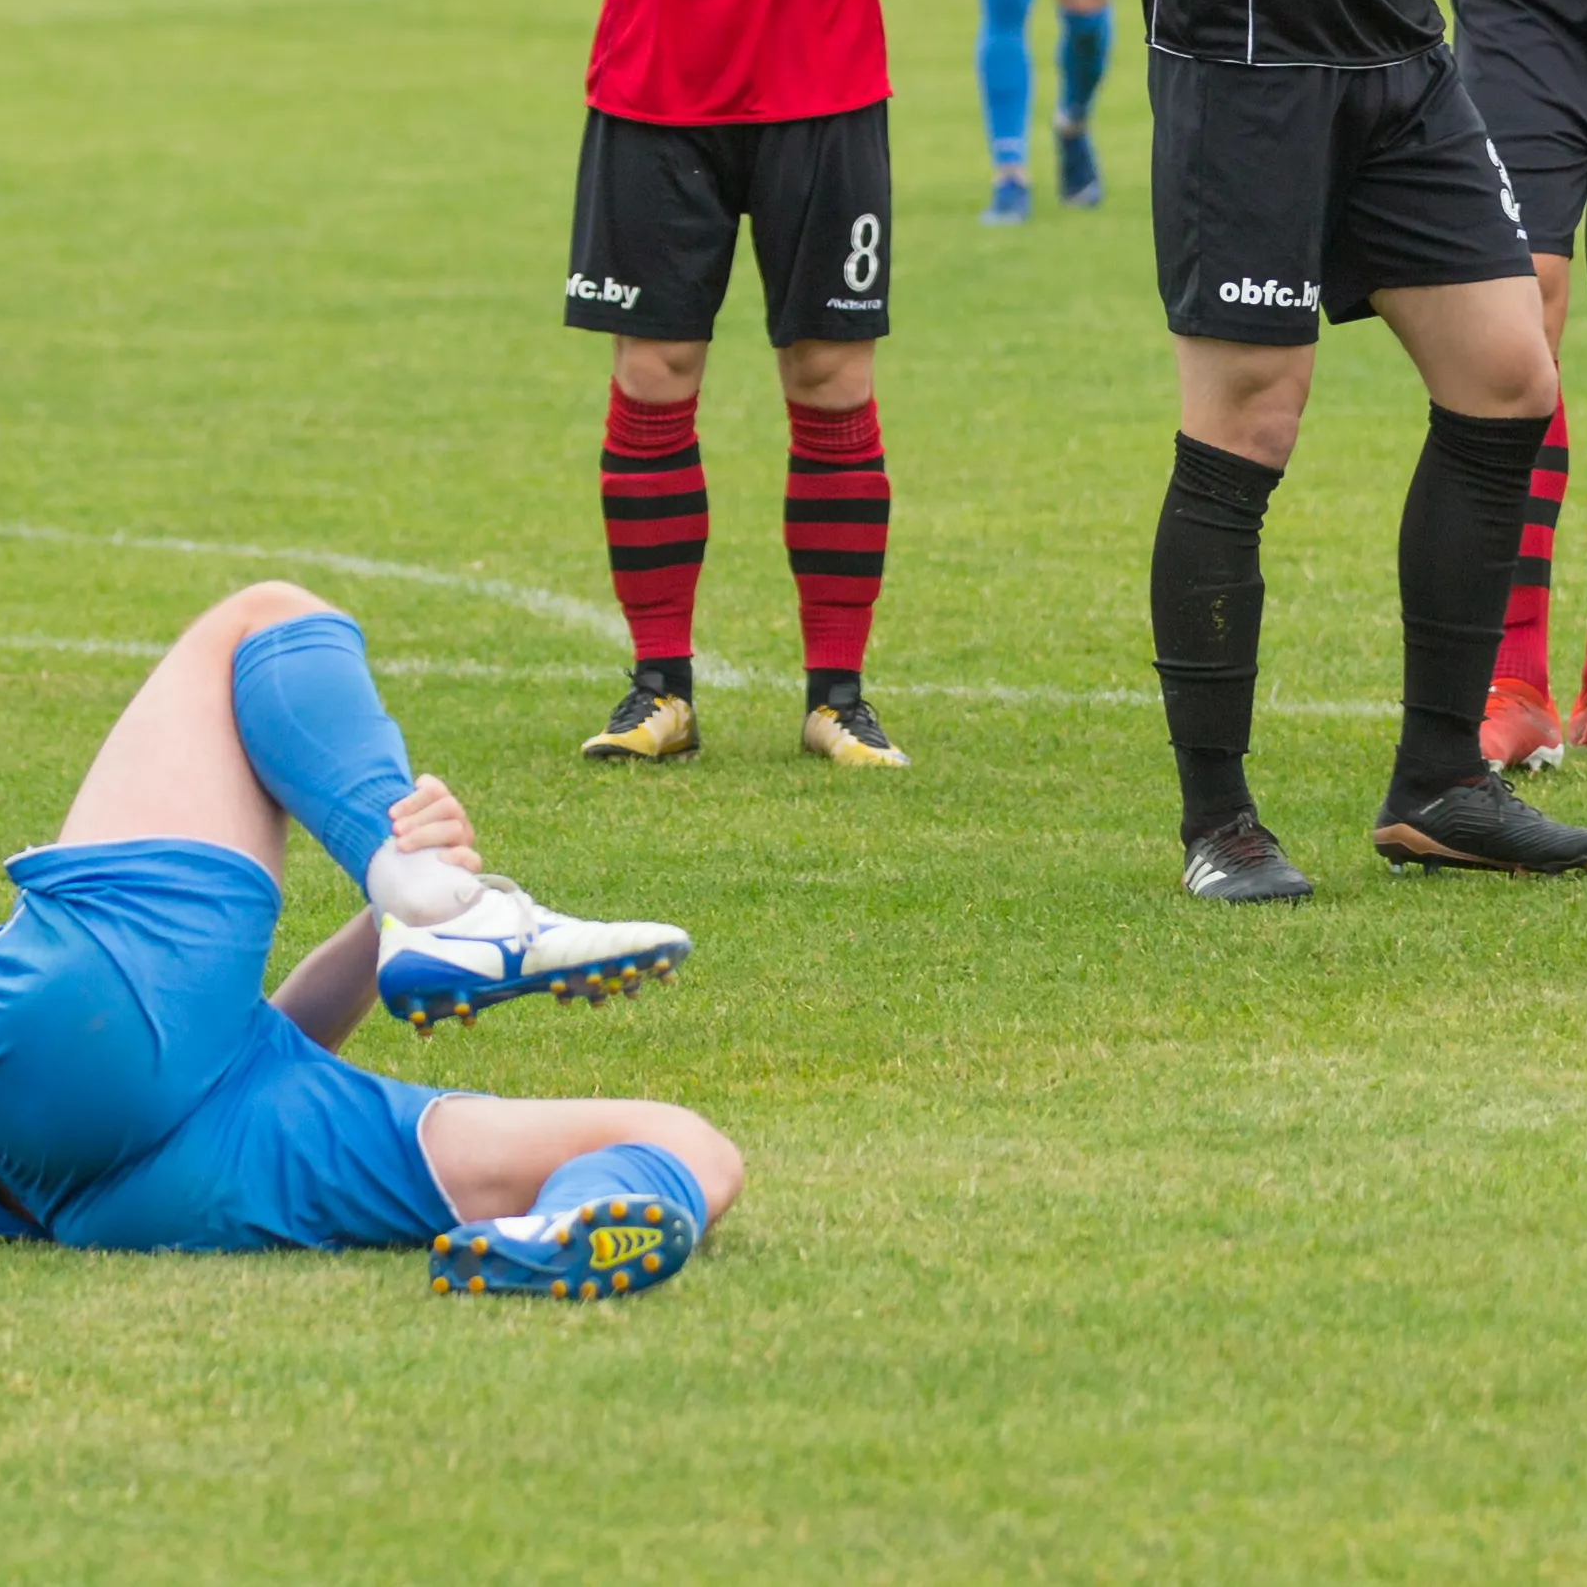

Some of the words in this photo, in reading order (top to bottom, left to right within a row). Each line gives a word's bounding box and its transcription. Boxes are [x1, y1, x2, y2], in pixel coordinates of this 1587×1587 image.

[843, 212, 881, 292] 8
[565, 272, 642, 310] fc.by
[1218, 276, 1322, 312] obfc.by
